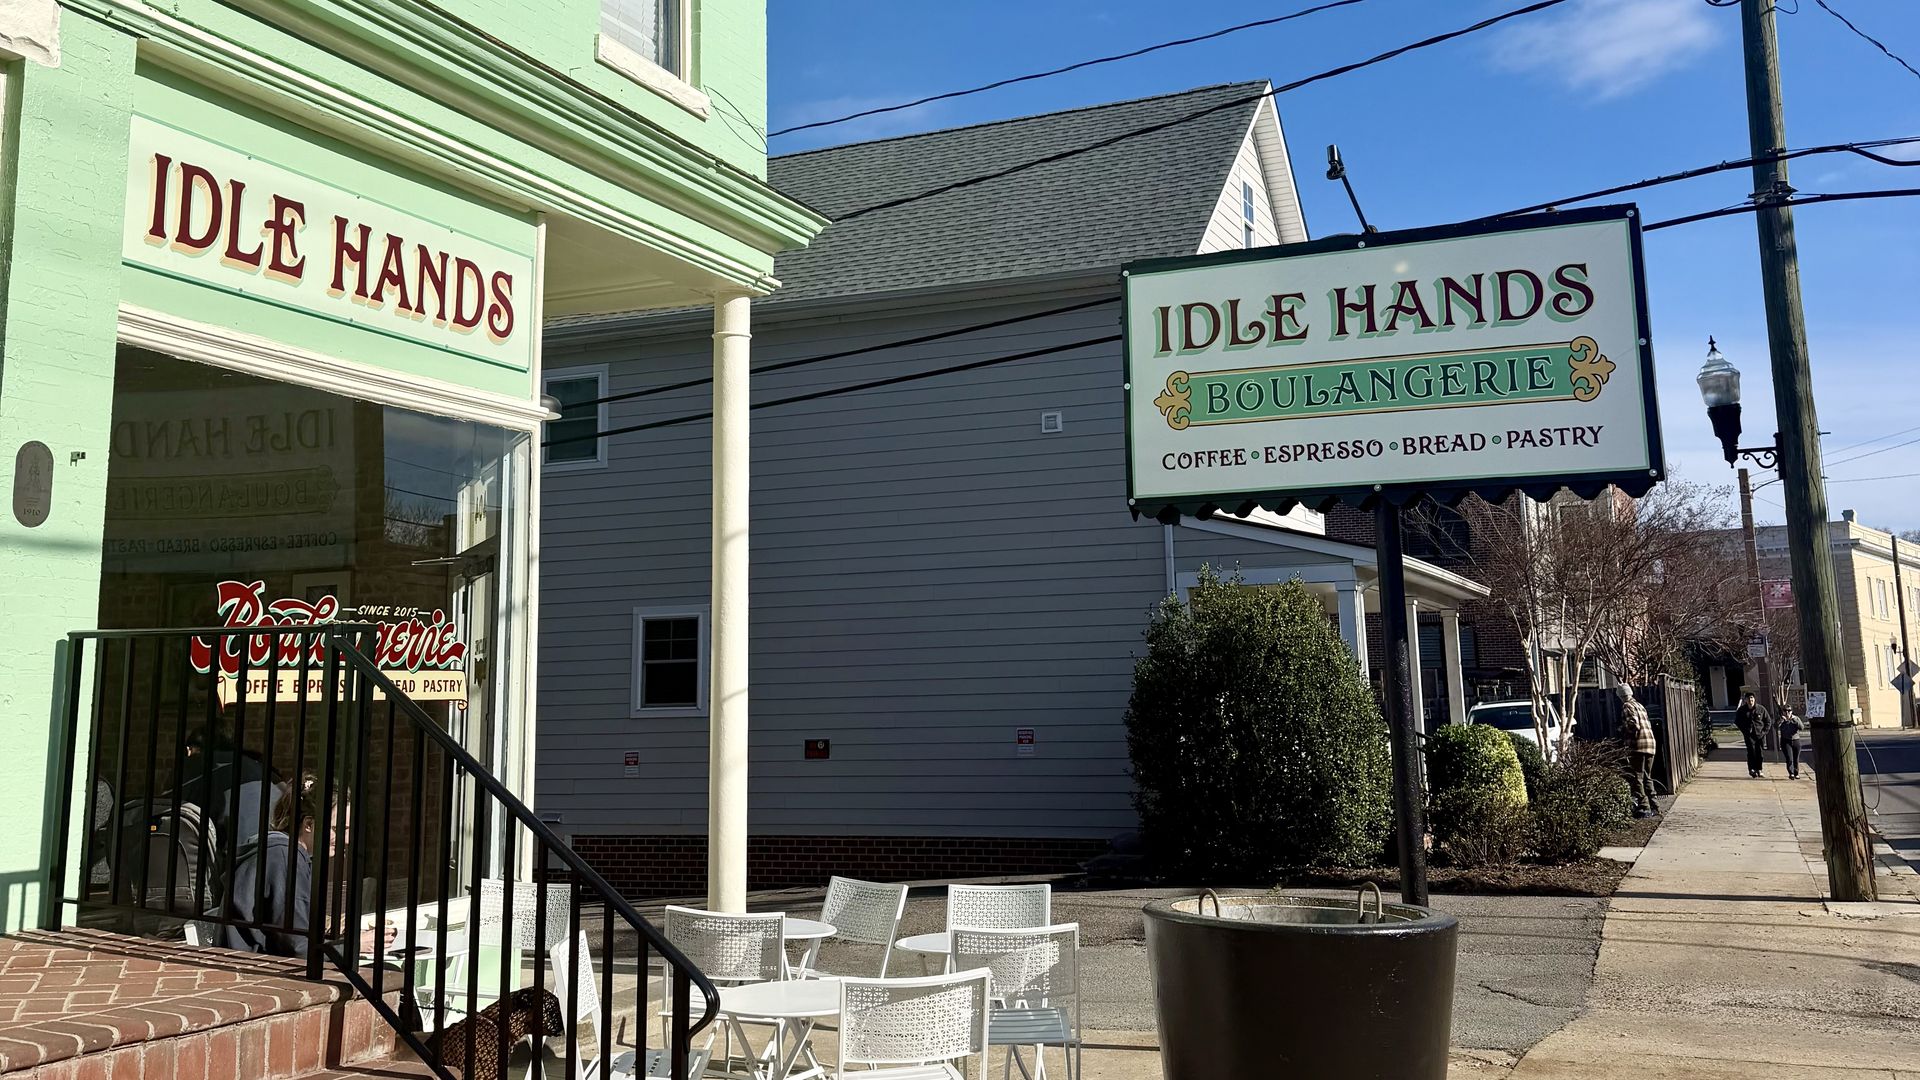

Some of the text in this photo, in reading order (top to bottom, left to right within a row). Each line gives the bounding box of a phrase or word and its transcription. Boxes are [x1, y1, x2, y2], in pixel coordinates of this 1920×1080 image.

[146, 152, 515, 341] IDLE HANDS
[1156, 262, 1595, 355] IDLE HANDS
[1205, 354, 1555, 415] BOULANGERIE
[1161, 425, 1604, 471] COFFEE ESPRESSO BREAD PASTRY
[190, 580, 468, 679] Boulgerie
[357, 605, 418, 618] SINCE 2015
[235, 679, 284, 694] OFFE
[423, 679, 463, 693] PASTRY
